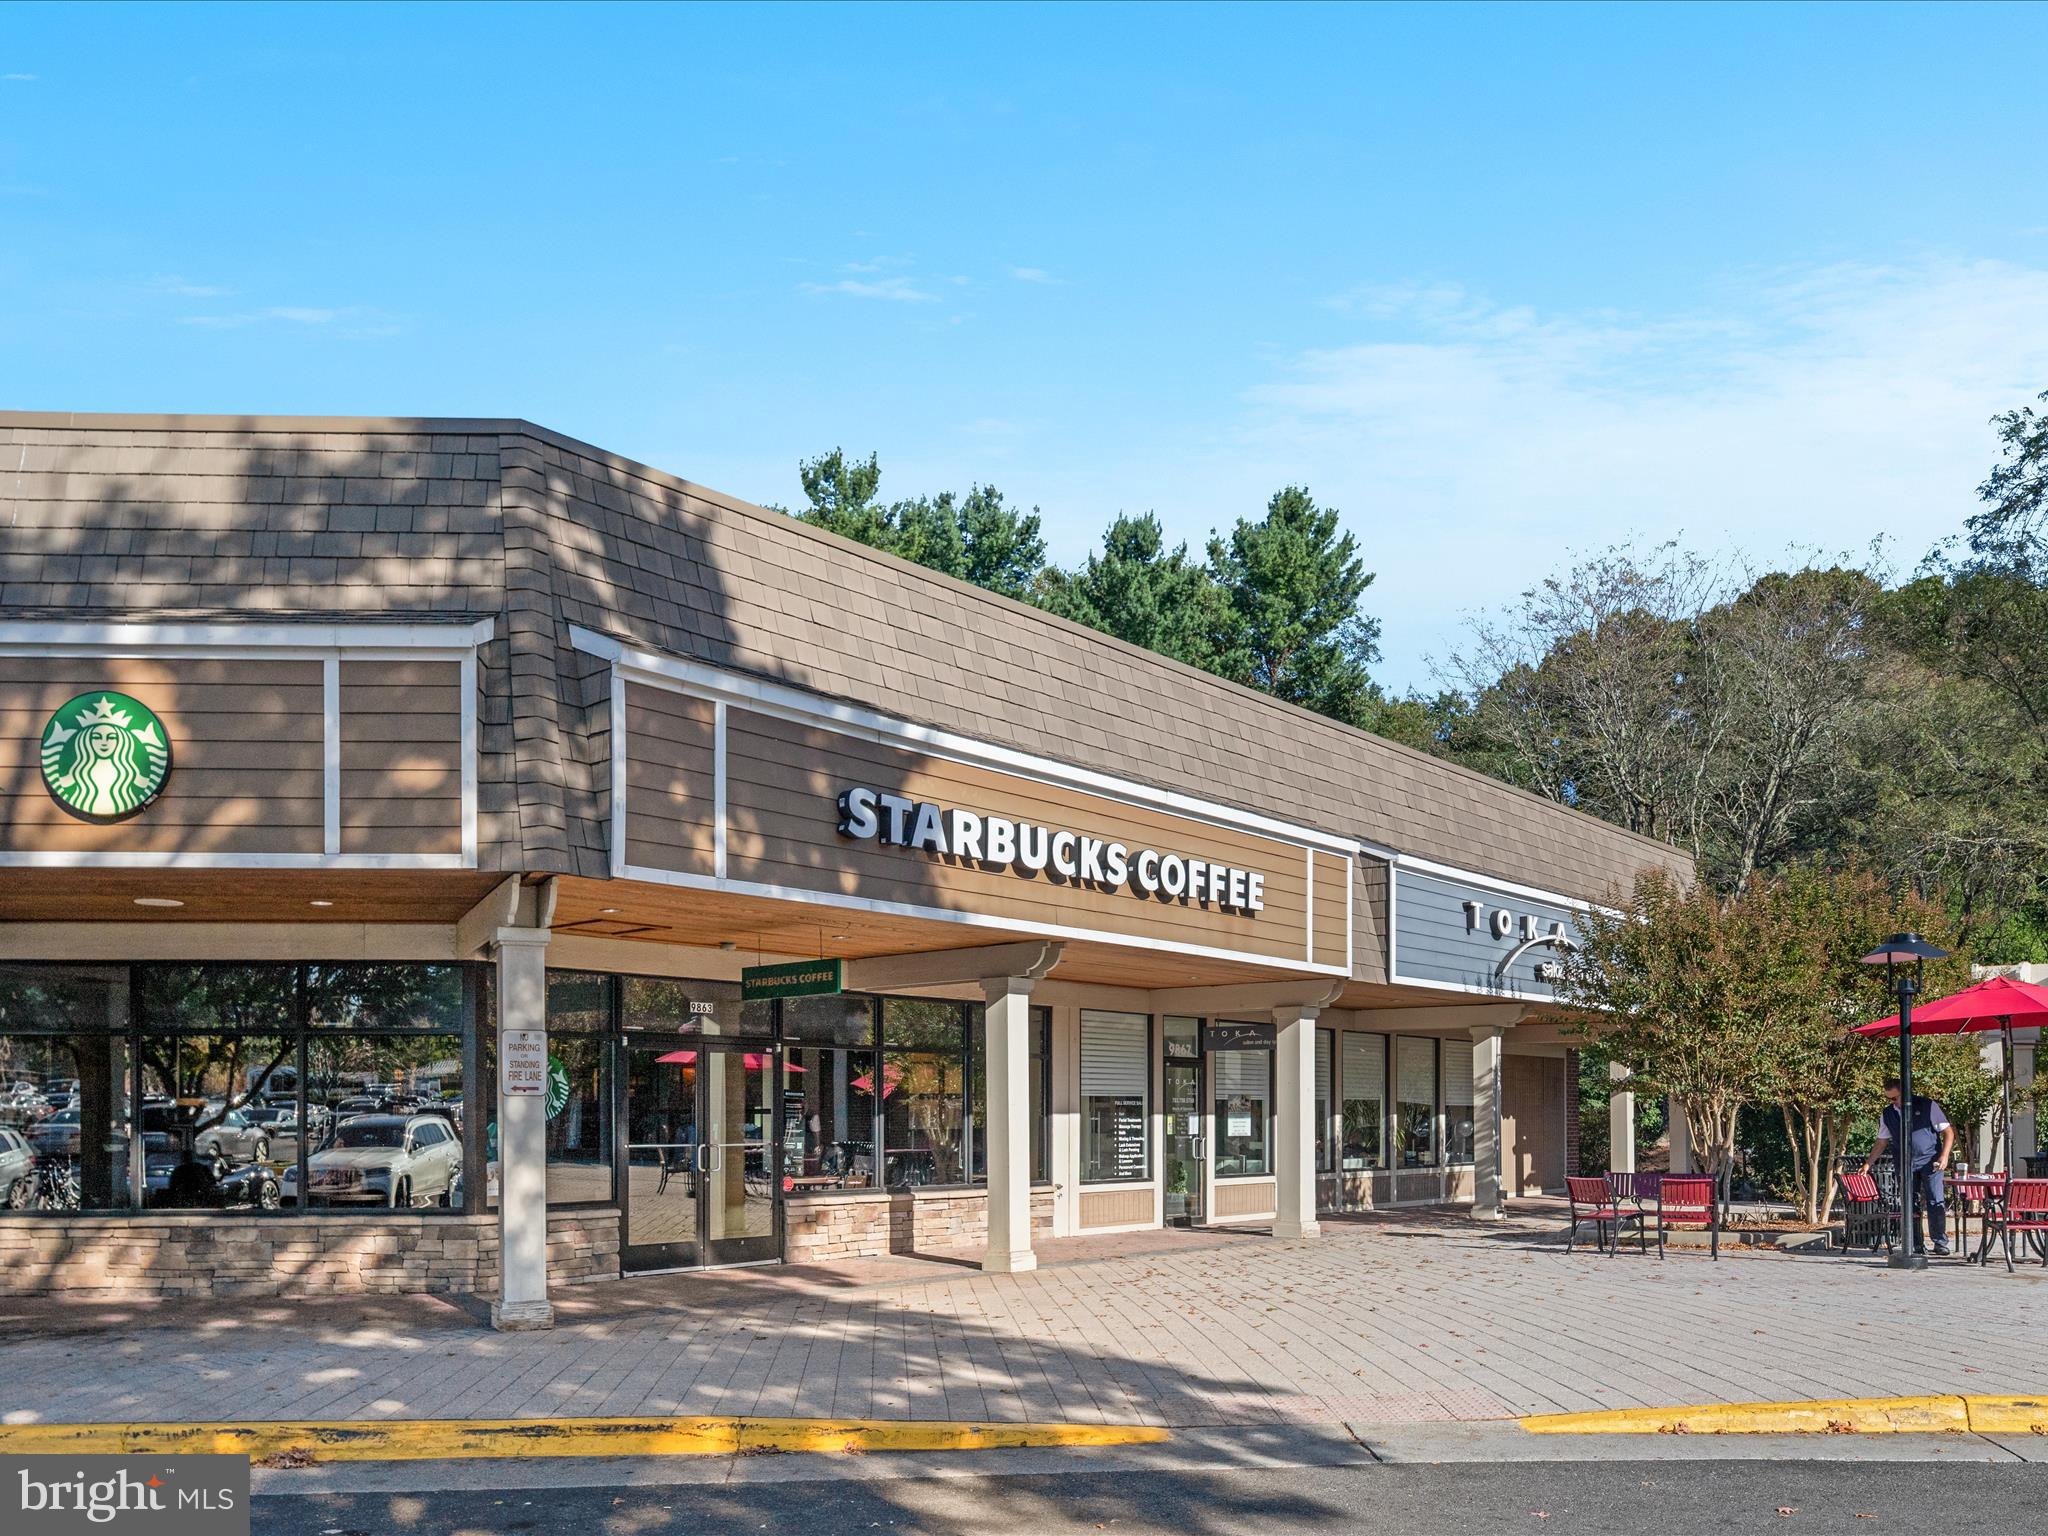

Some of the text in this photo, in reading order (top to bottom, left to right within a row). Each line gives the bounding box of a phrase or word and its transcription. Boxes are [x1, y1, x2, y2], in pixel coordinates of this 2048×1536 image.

[842, 787, 1265, 912] STARBUCKS COFFEE
[1464, 901, 1569, 947] TOKA
[745, 971, 833, 989] STARBUCKS COFFEE
[690, 1003, 713, 1013] 9863
[519, 1033, 529, 1041] NO
[1209, 1030, 1256, 1038] TOKA
[508, 1043, 541, 1052] PARKING
[509, 1060, 540, 1069] STANDING
[508, 1070, 542, 1081] FIRE LANE
